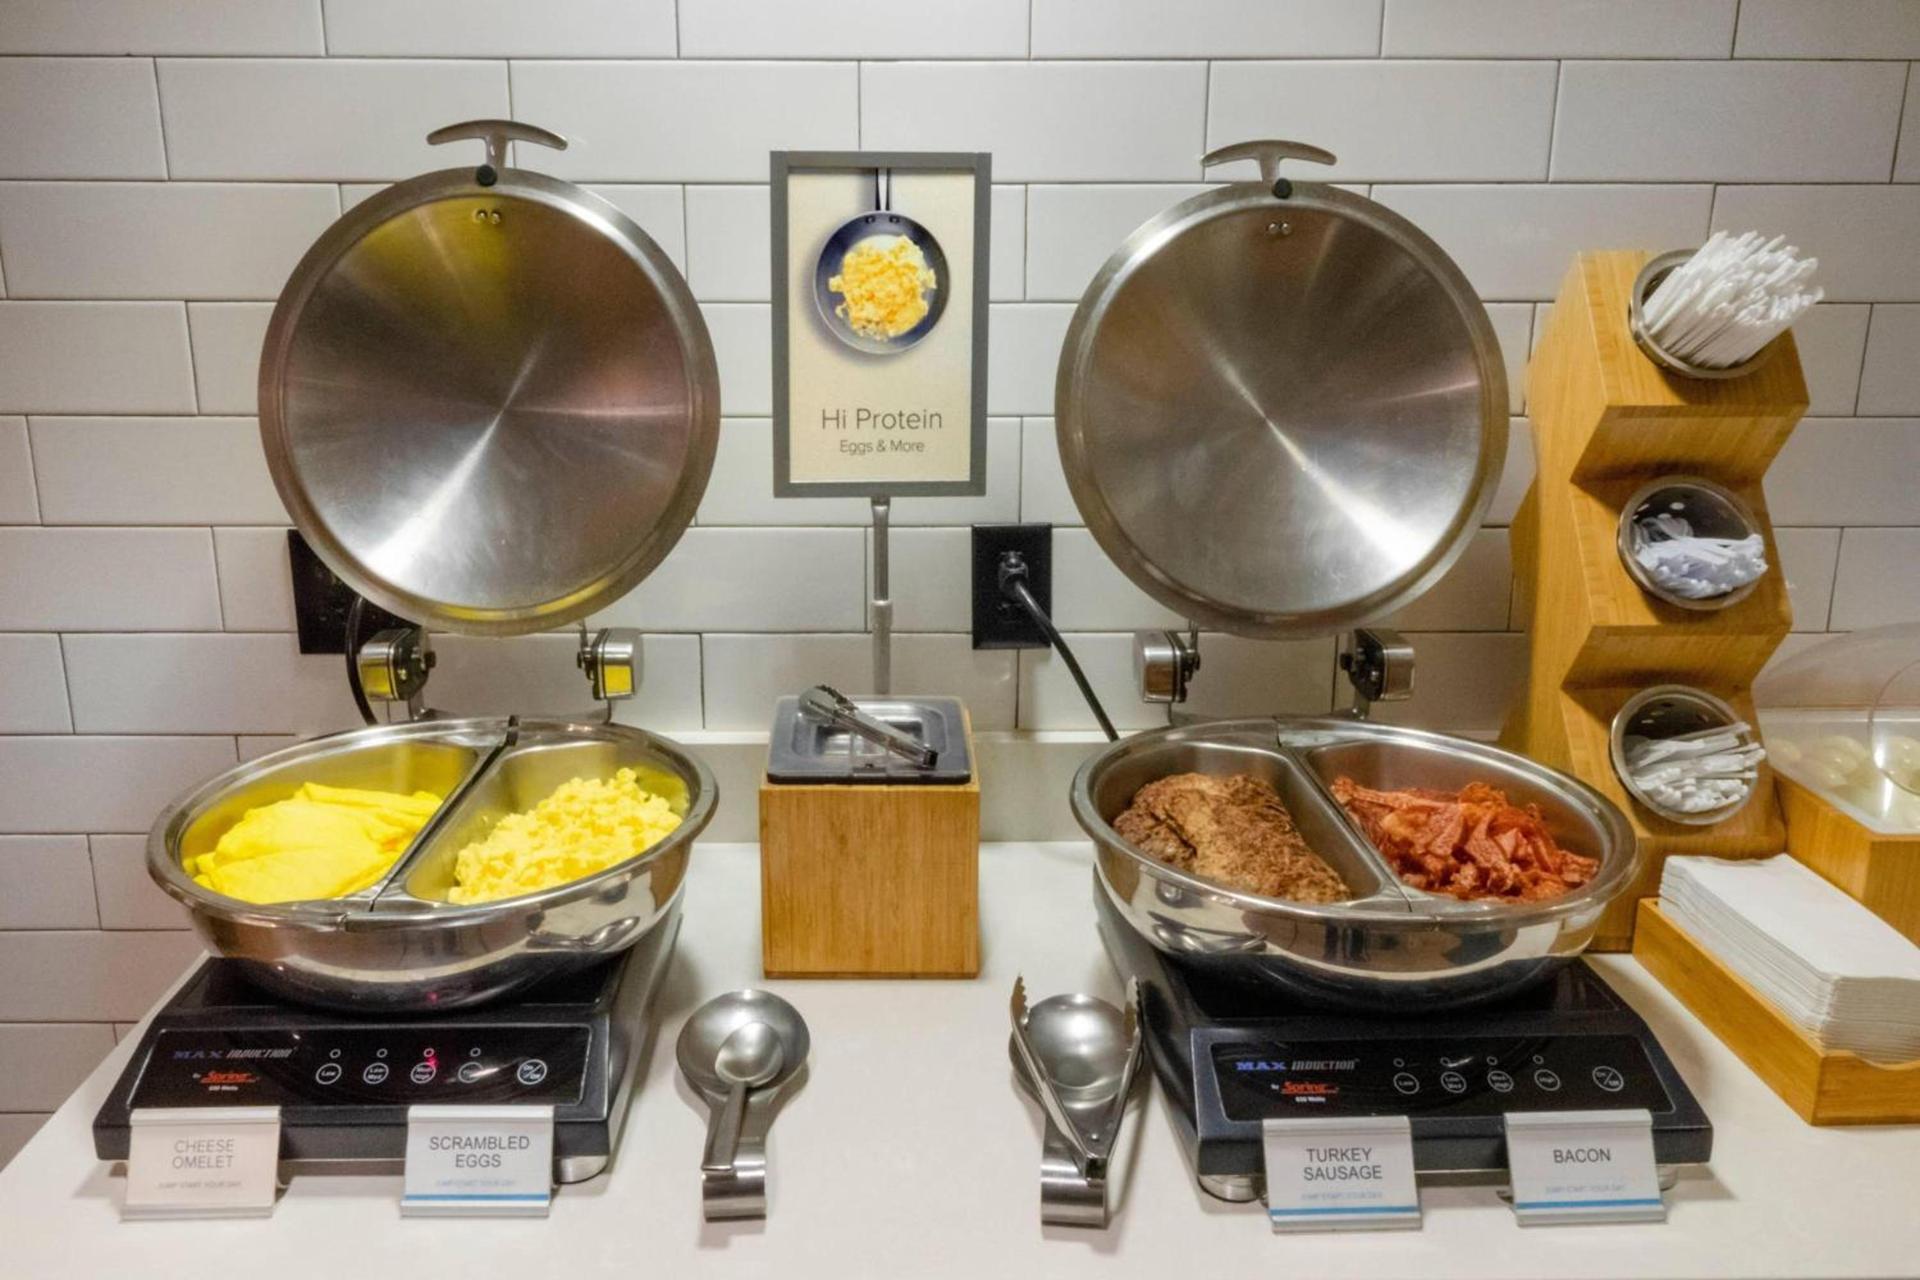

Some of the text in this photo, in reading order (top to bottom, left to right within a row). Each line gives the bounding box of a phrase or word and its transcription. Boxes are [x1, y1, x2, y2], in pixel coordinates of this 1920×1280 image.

[822, 408, 942, 430] Hi Protein
[840, 439, 925, 456] Eggs & More
[1236, 1060, 1355, 1070] MAX INDUCTION
[173, 1138, 235, 1153] CHEESE
[429, 1135, 530, 1151] SCRAMBLED
[172, 1154, 235, 1169] OMELET
[455, 1153, 502, 1168] EGGS
[1305, 1147, 1373, 1163] TURKEY
[1553, 1148, 1612, 1163] BACON
[1303, 1164, 1383, 1181] SAUSAGE
